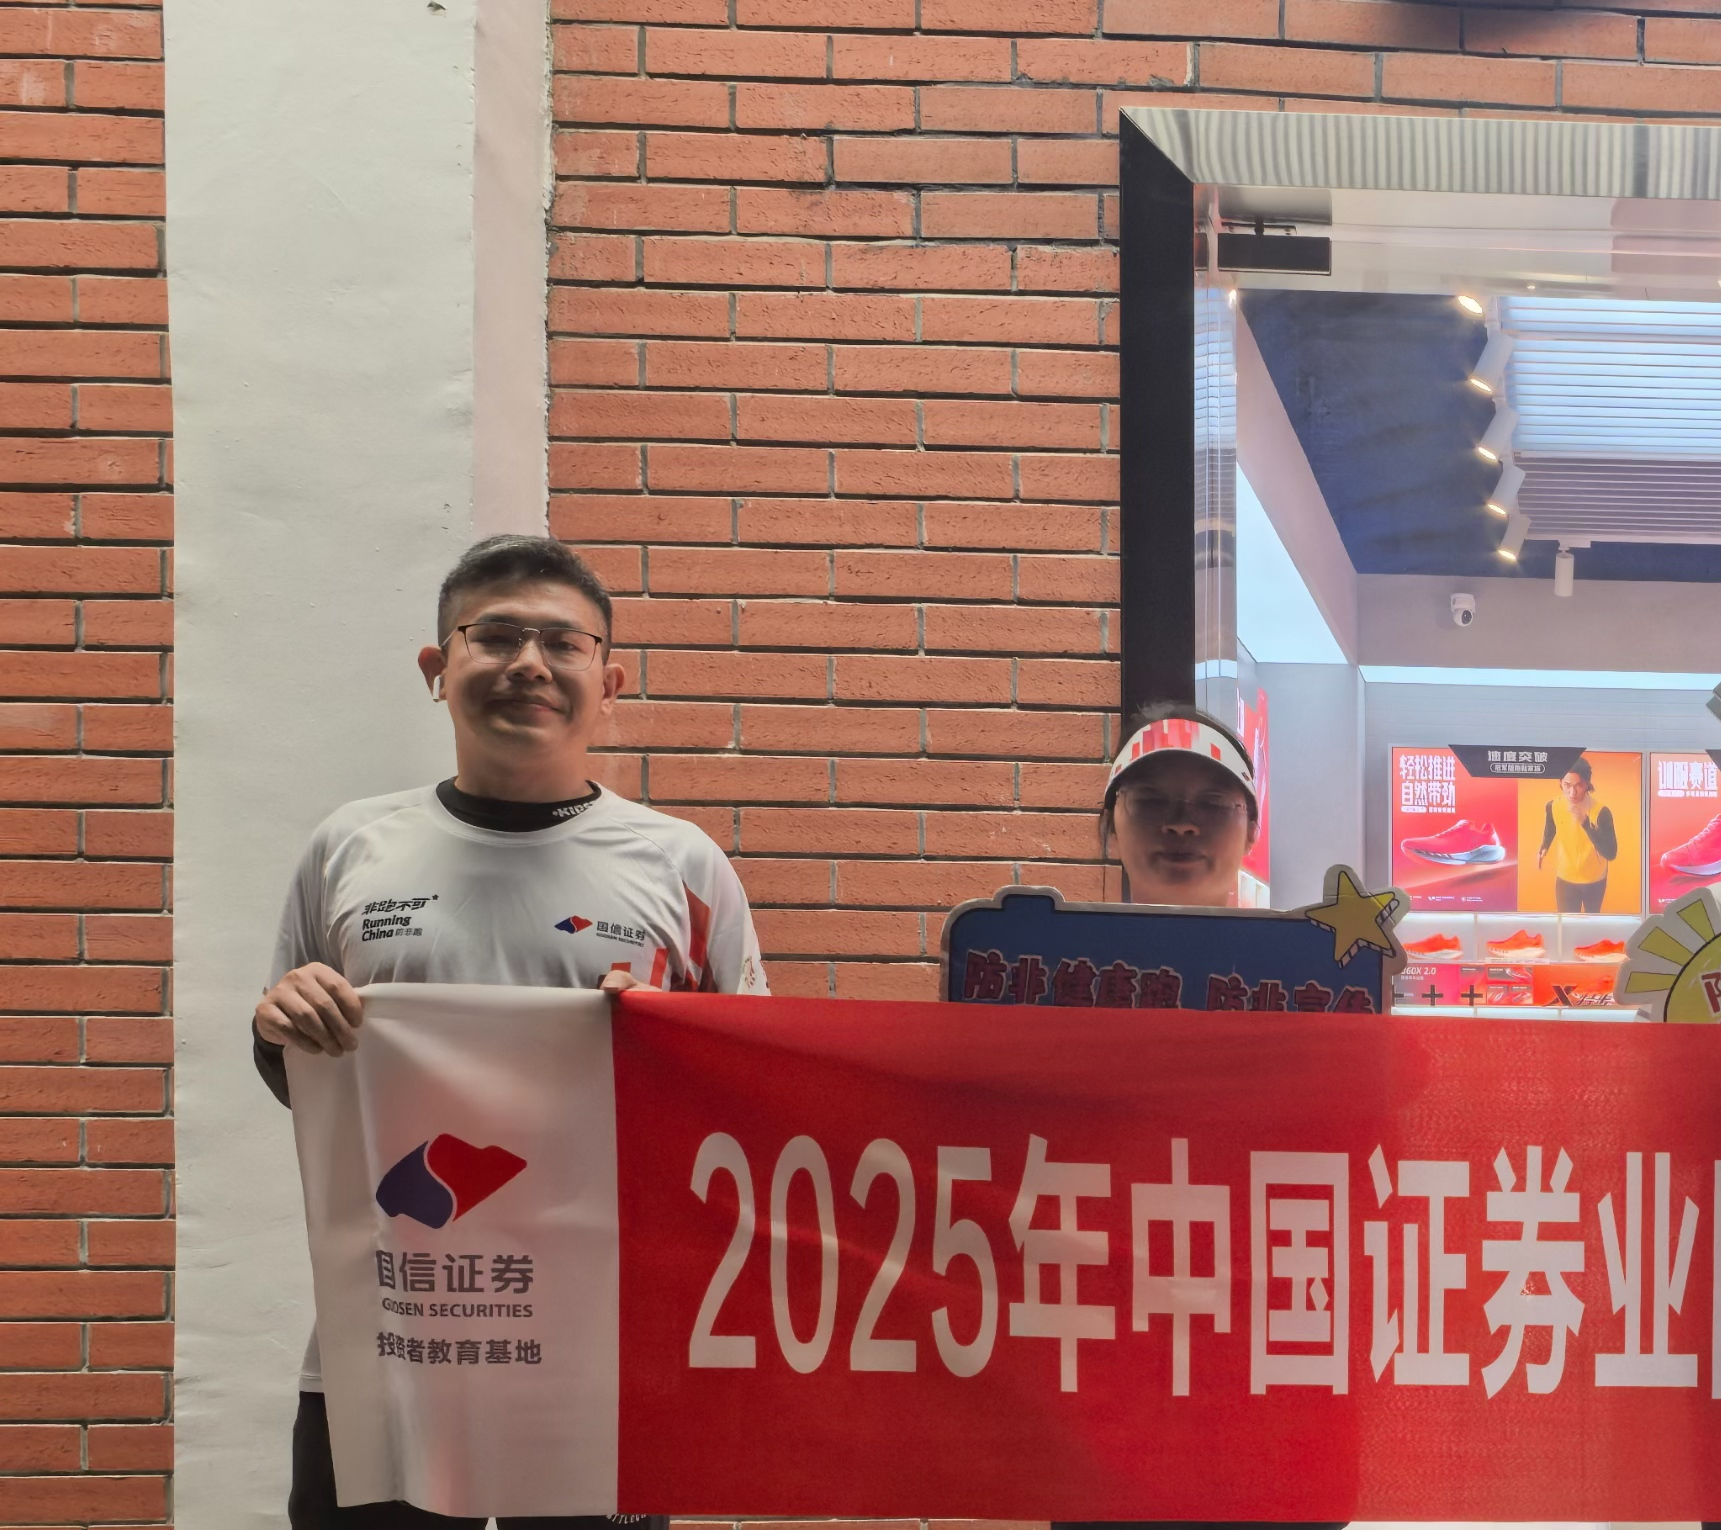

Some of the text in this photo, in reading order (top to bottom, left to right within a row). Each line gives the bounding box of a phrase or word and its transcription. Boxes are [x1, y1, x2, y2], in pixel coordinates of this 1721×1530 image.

[1487, 750, 1548, 762] 速度突破
[1400, 755, 1455, 780] 轻松推进
[1401, 781, 1456, 806] 自然带劲
[362, 915, 412, 931] Running
[596, 920, 646, 941] 国信证券
[362, 928, 394, 941] China
[428, 1303, 534, 1318] SECURITIES
